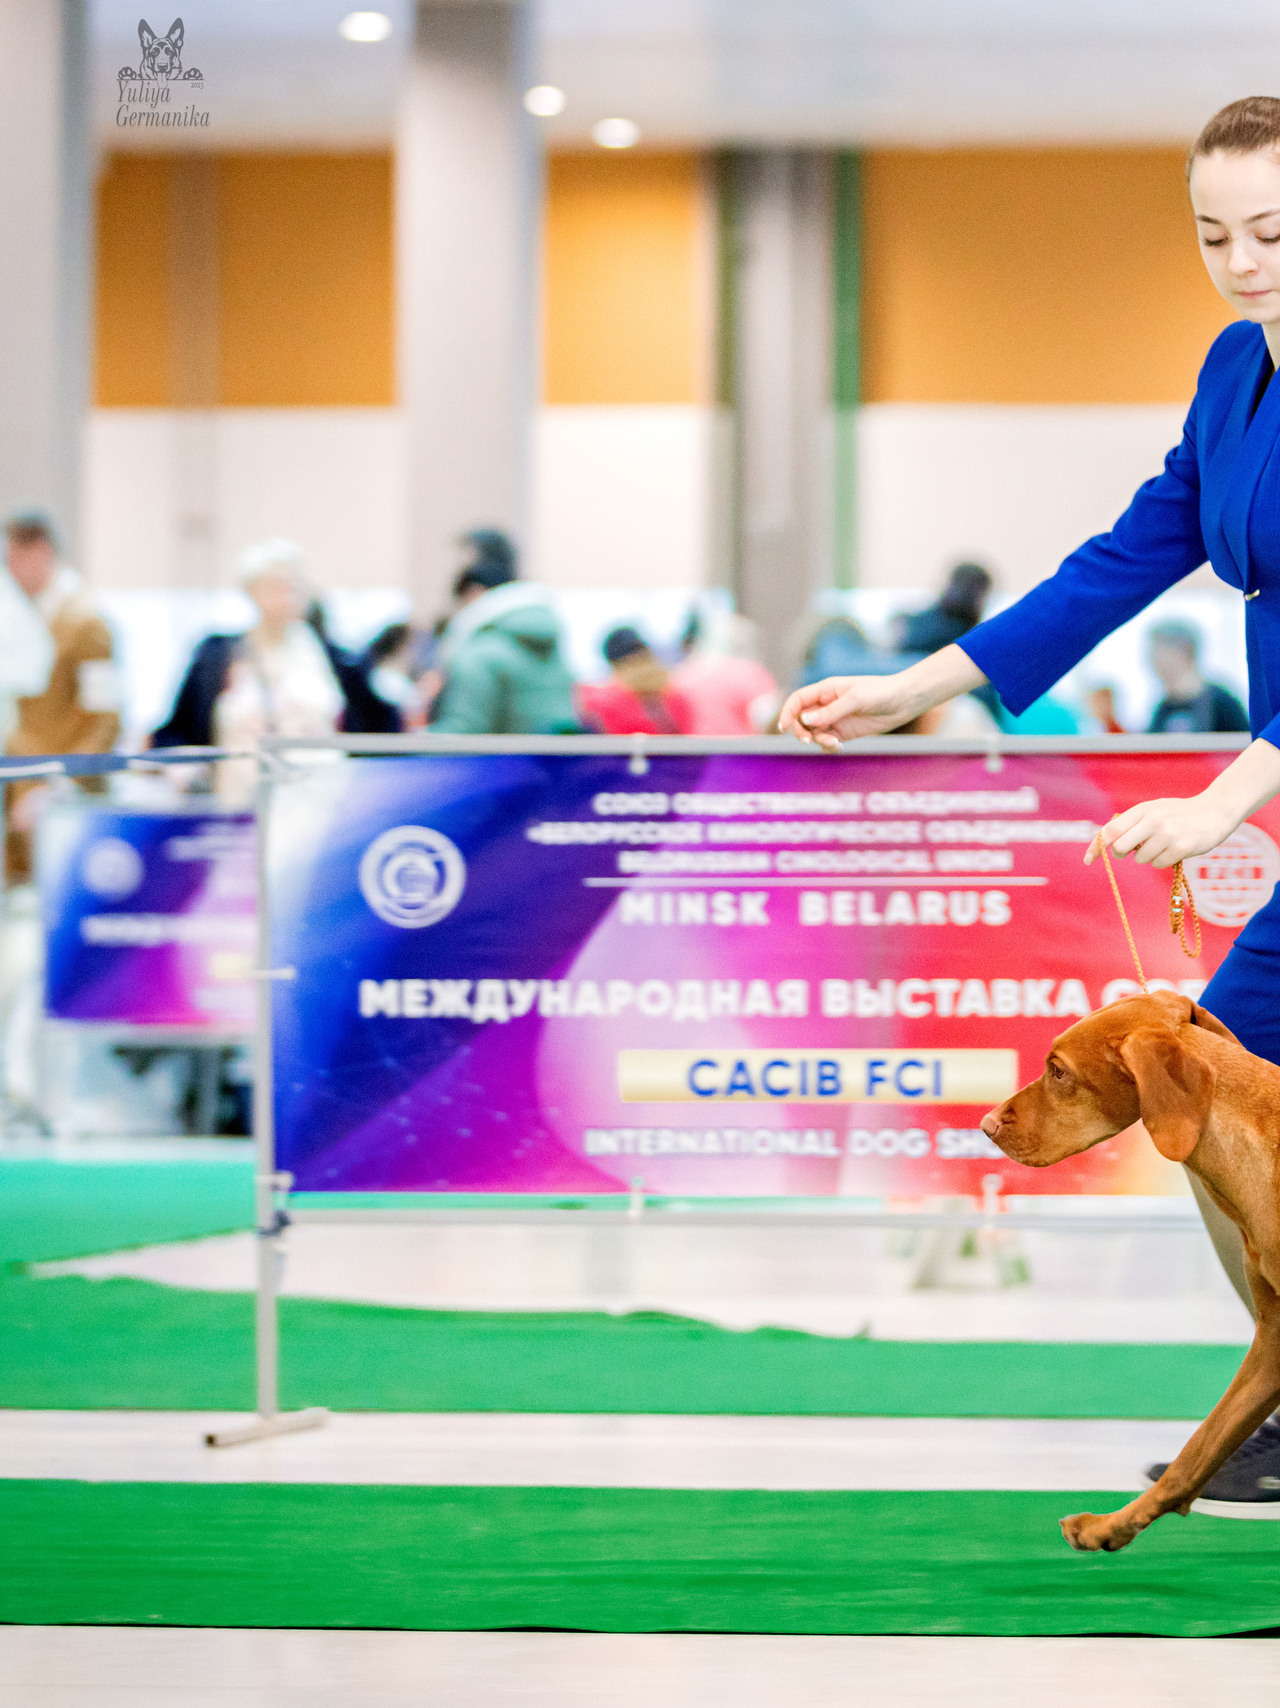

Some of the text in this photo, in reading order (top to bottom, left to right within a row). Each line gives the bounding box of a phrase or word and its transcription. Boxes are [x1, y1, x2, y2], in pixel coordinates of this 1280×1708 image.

[620, 890, 1011, 925] MINSK BELARUS
[359, 978, 811, 1022] МЕЖДУНАРОДНАЯ
[821, 978, 1092, 1017] ВЫСТАВКА
[687, 1059, 944, 1098] CACIB FCI
[584, 1128, 839, 1156] INTERNATIONAL
[850, 1128, 931, 1158] DOG
